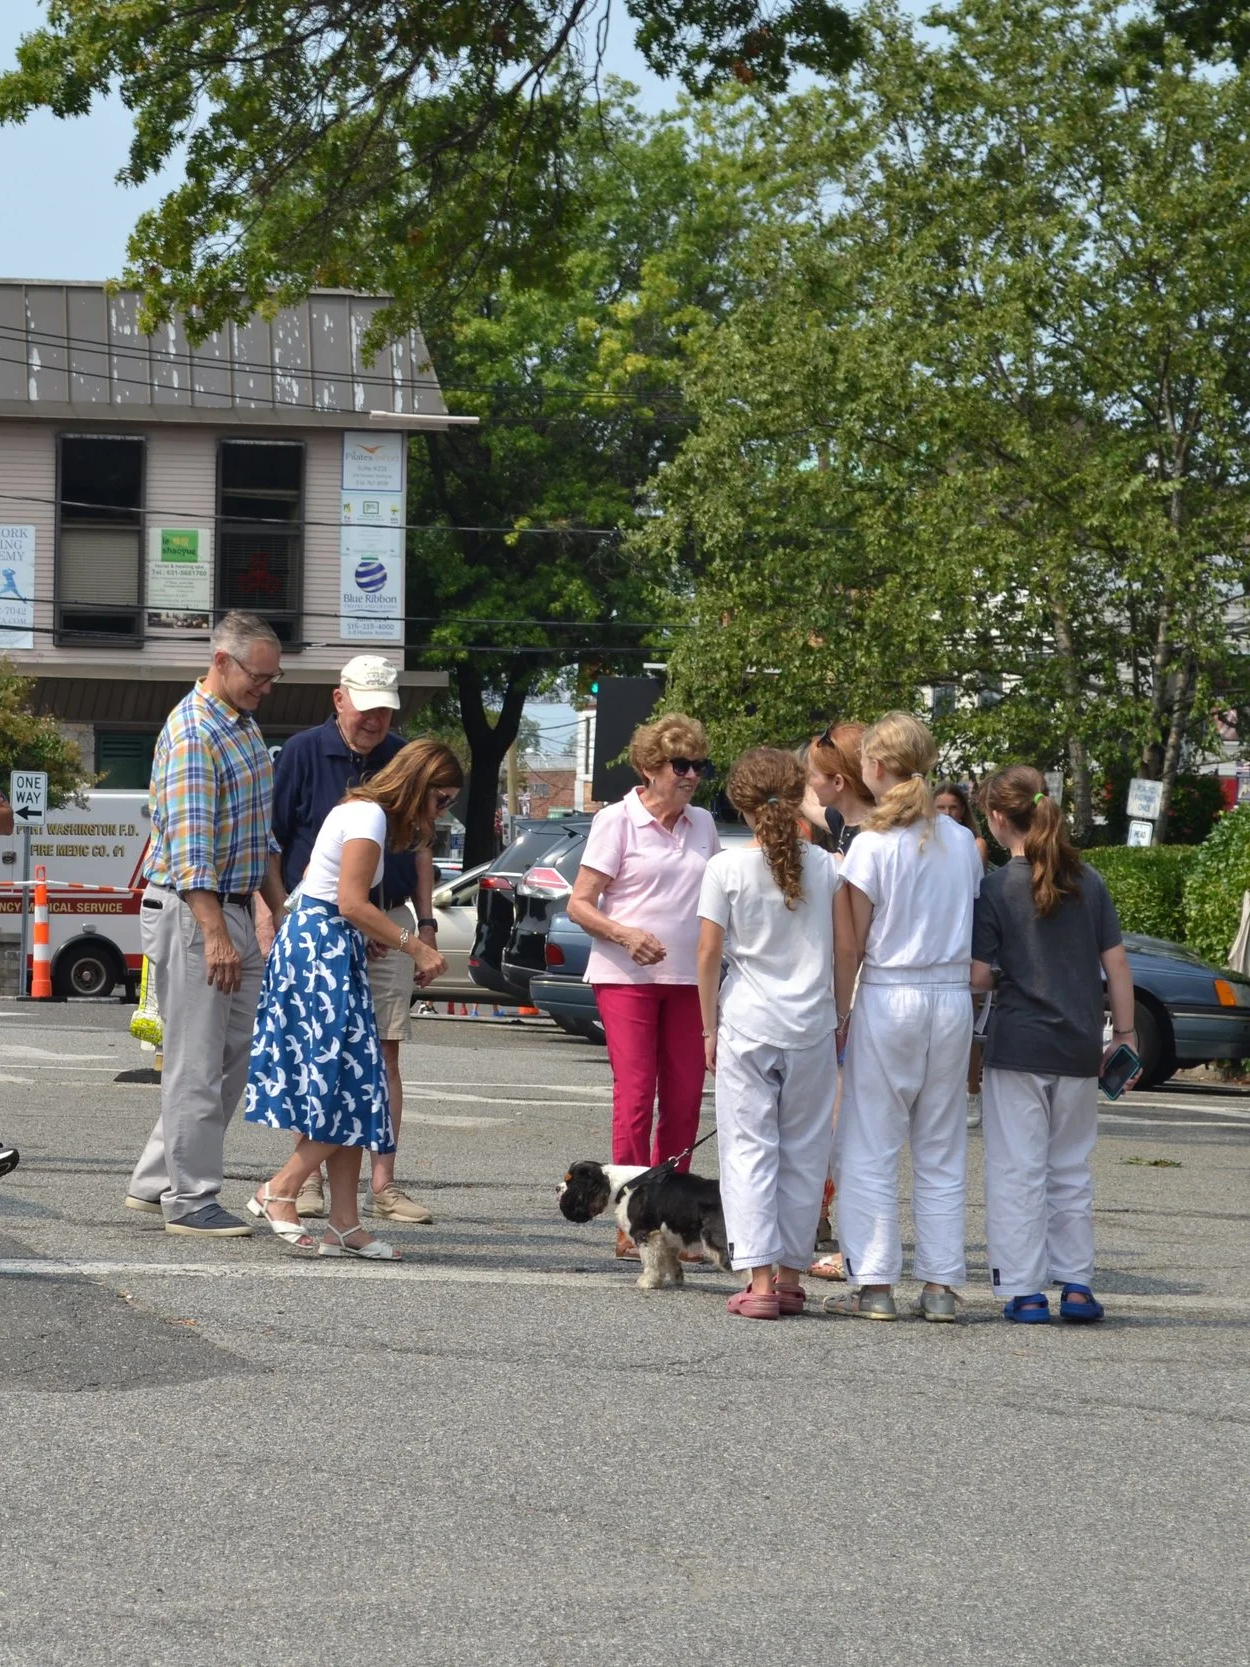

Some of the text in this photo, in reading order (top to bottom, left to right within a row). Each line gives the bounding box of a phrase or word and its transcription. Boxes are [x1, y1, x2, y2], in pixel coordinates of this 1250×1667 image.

[343, 593, 397, 603] Blue Ribbon
[16, 776, 41, 789] ONE
[16, 791, 41, 804] WAY
[16, 823, 139, 836] PRT WASHINGTON F.D.
[30, 844, 54, 856] FIRE
[56, 844, 90, 857] MEDIC
[92, 844, 110, 857] CO.
[76, 902, 123, 912] SERVICE
